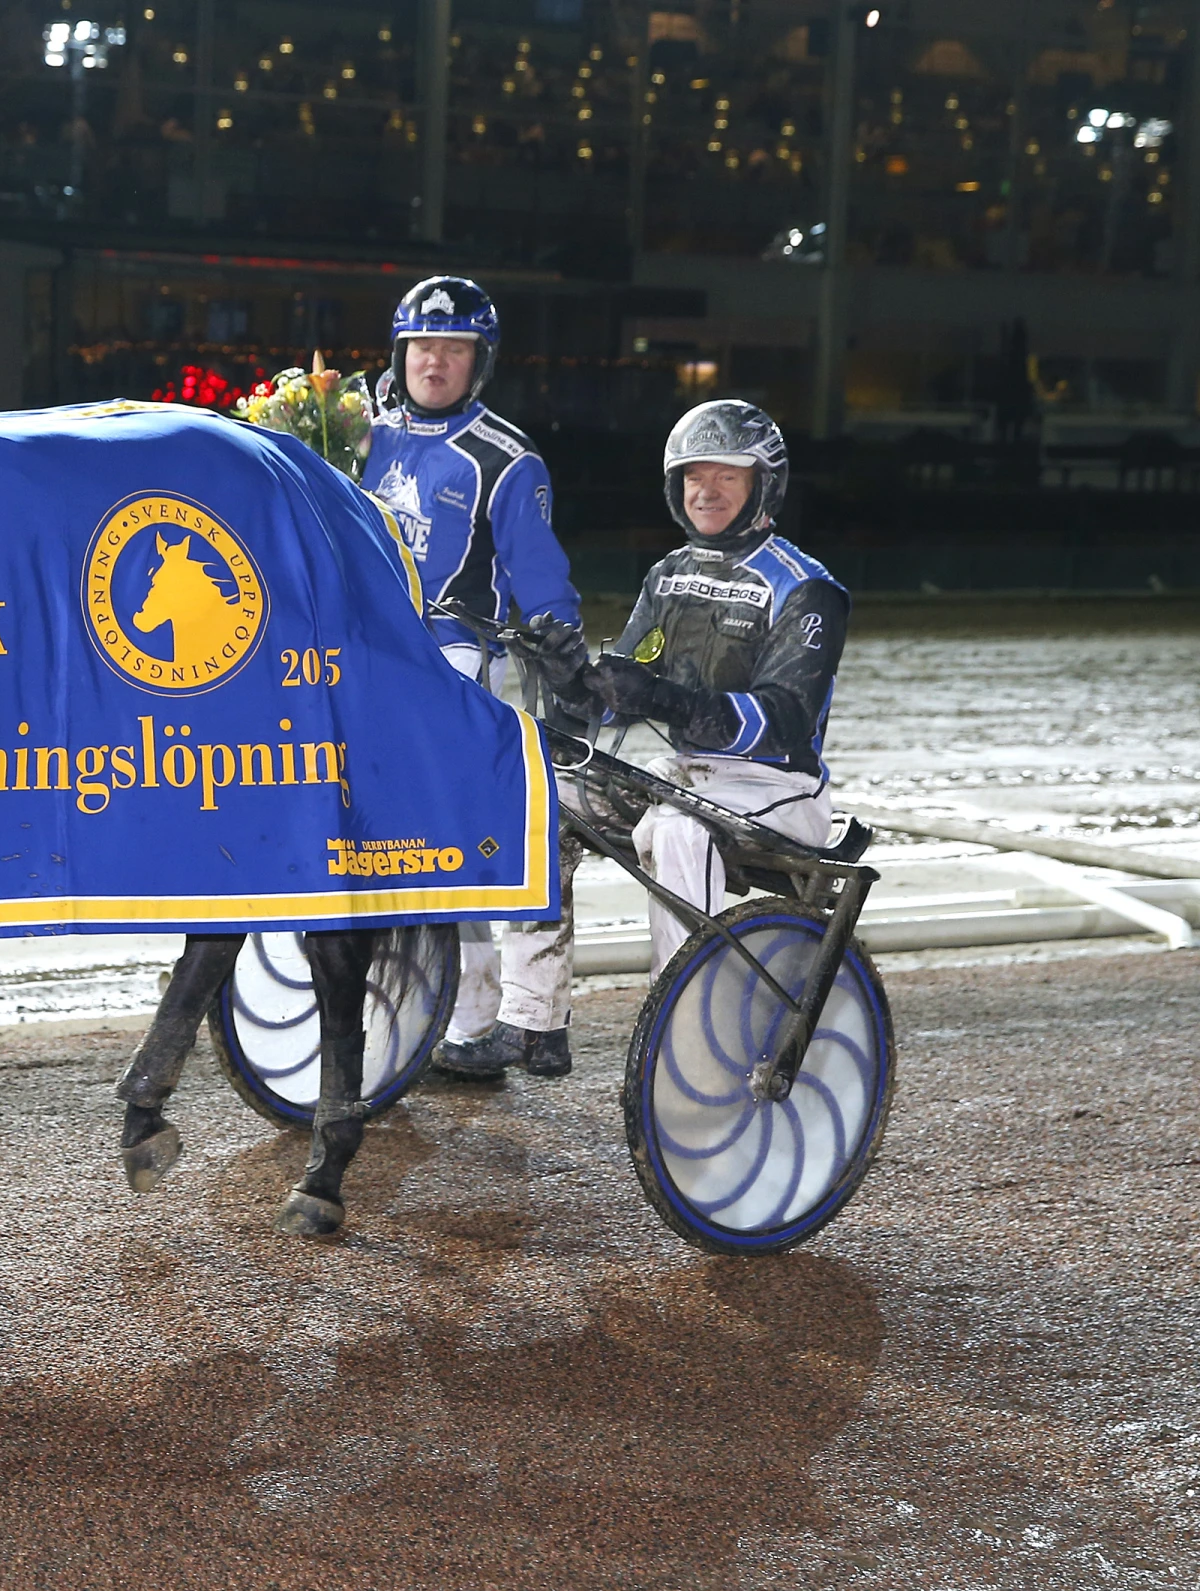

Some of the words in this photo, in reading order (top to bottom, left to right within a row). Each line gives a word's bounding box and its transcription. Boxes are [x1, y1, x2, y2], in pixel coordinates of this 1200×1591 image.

[474, 423, 520, 455] broline.se
[128, 503, 221, 544] SVENSK
[92, 530, 257, 683] UPPFÖDNINGSLÖPNING
[327, 838, 465, 877] Jägersro
[361, 838, 427, 851] DERBYBANAN
